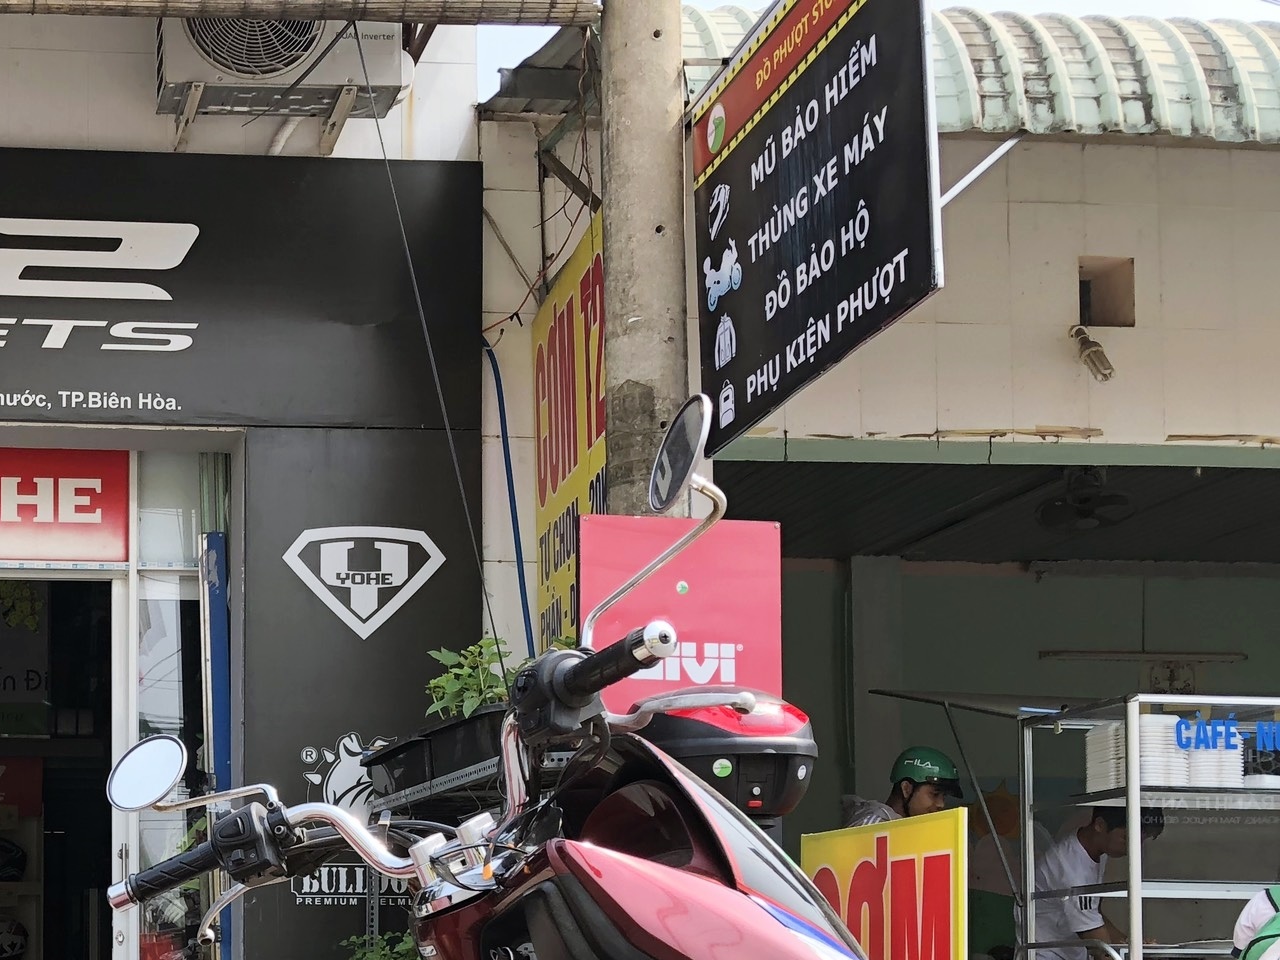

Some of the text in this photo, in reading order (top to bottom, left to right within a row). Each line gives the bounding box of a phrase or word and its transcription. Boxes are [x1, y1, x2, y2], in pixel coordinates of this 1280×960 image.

[361, 32, 396, 41] Inverter
[749, 33, 878, 192] MŨ BẢO HIỂM
[747, 106, 889, 265] THÙNG XE MÁY
[764, 199, 871, 323] ĐỒ BẢO HỘ
[745, 249, 909, 404] PHỤ KIỆN PHƯỢT
[58, 390, 132, 409] TP.Biên
[138, 392, 182, 411] Hòa.
[535, 293, 578, 508] CƠM
[335, 572, 393, 586] YOHE
[24, 668, 49, 692] Đi
[904, 758, 932, 768] FILA
[296, 897, 358, 906] PREMIUM
